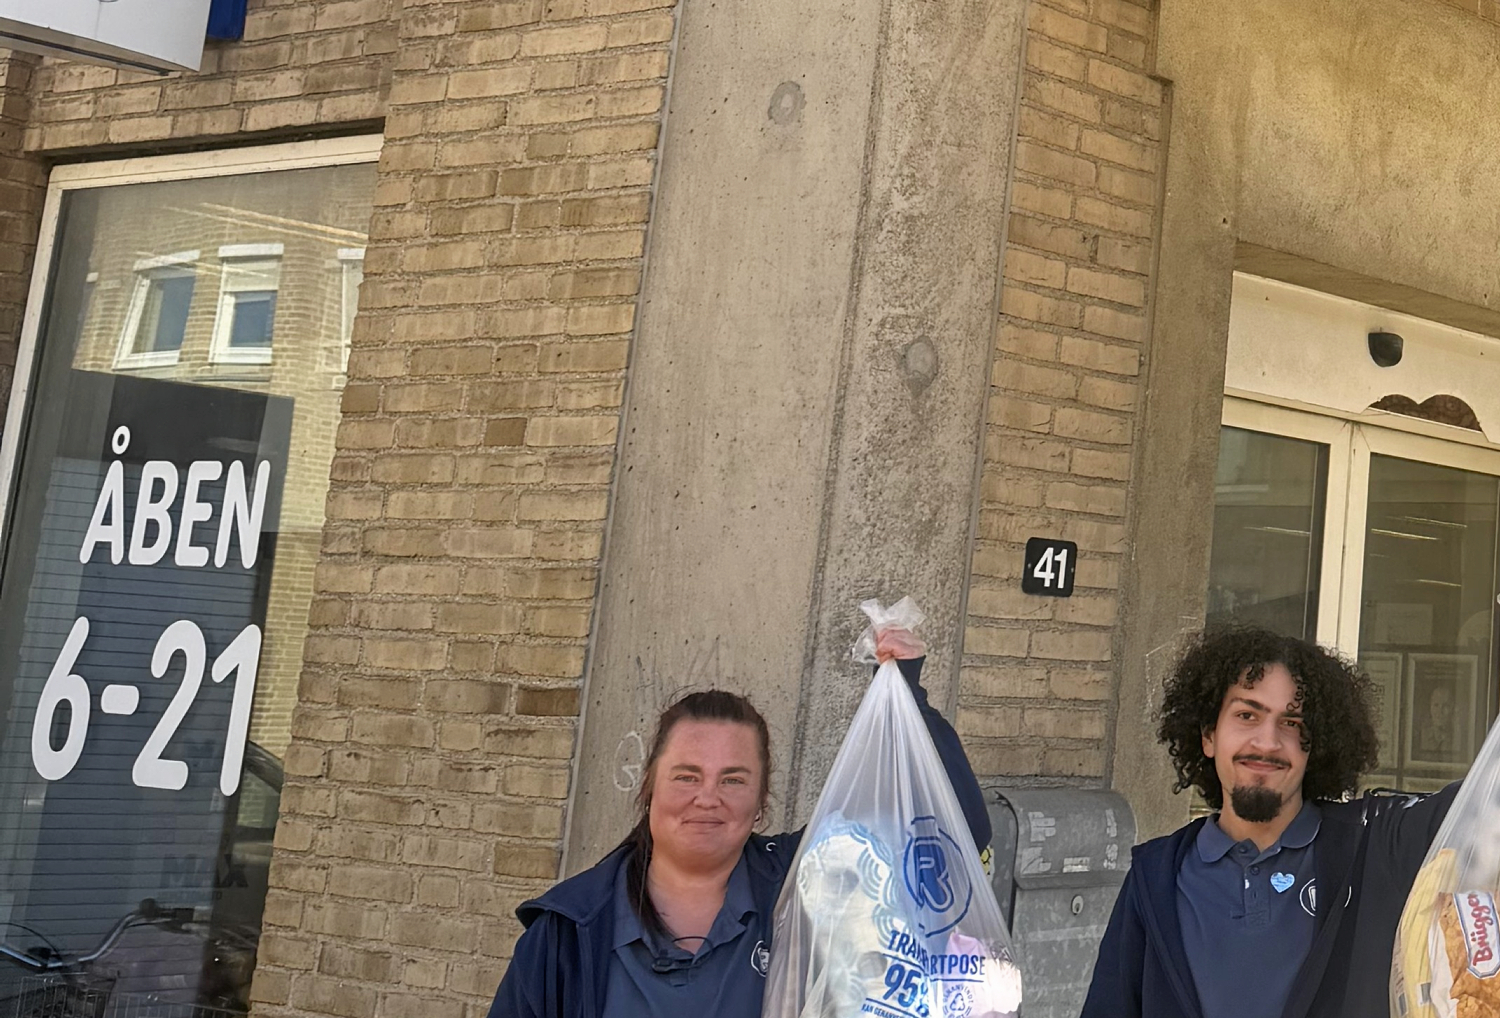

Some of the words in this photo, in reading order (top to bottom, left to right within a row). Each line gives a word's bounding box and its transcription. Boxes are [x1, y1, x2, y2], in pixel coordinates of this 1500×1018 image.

[79, 425, 271, 570] ÅBEN
[1033, 547, 1069, 589] 41
[31, 616, 262, 797] 6-21
